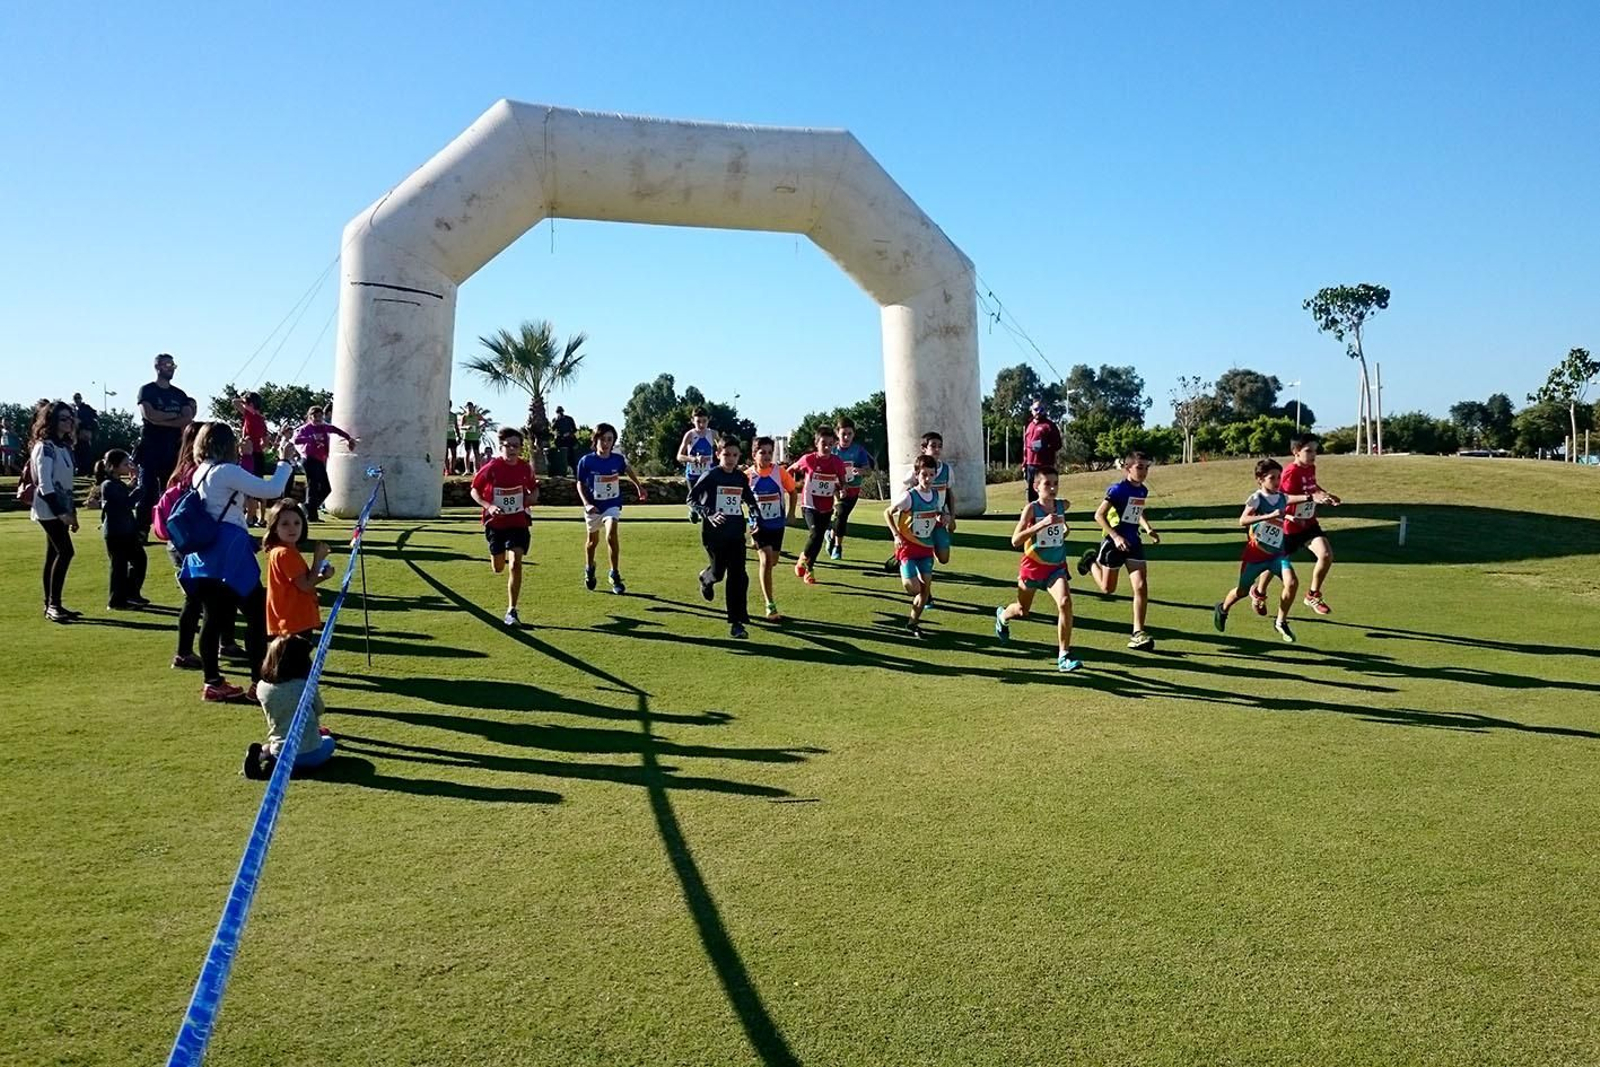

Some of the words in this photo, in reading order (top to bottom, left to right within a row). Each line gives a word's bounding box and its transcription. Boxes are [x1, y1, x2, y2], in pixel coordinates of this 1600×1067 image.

[606, 483, 612, 491] 5
[819, 481, 829, 489] 96
[503, 496, 515, 505] 88
[726, 496, 737, 505] 35
[760, 503, 772, 511] 77
[924, 520, 930, 529] 3
[1047, 526, 1060, 536] 65
[1265, 525, 1280, 537] 150
